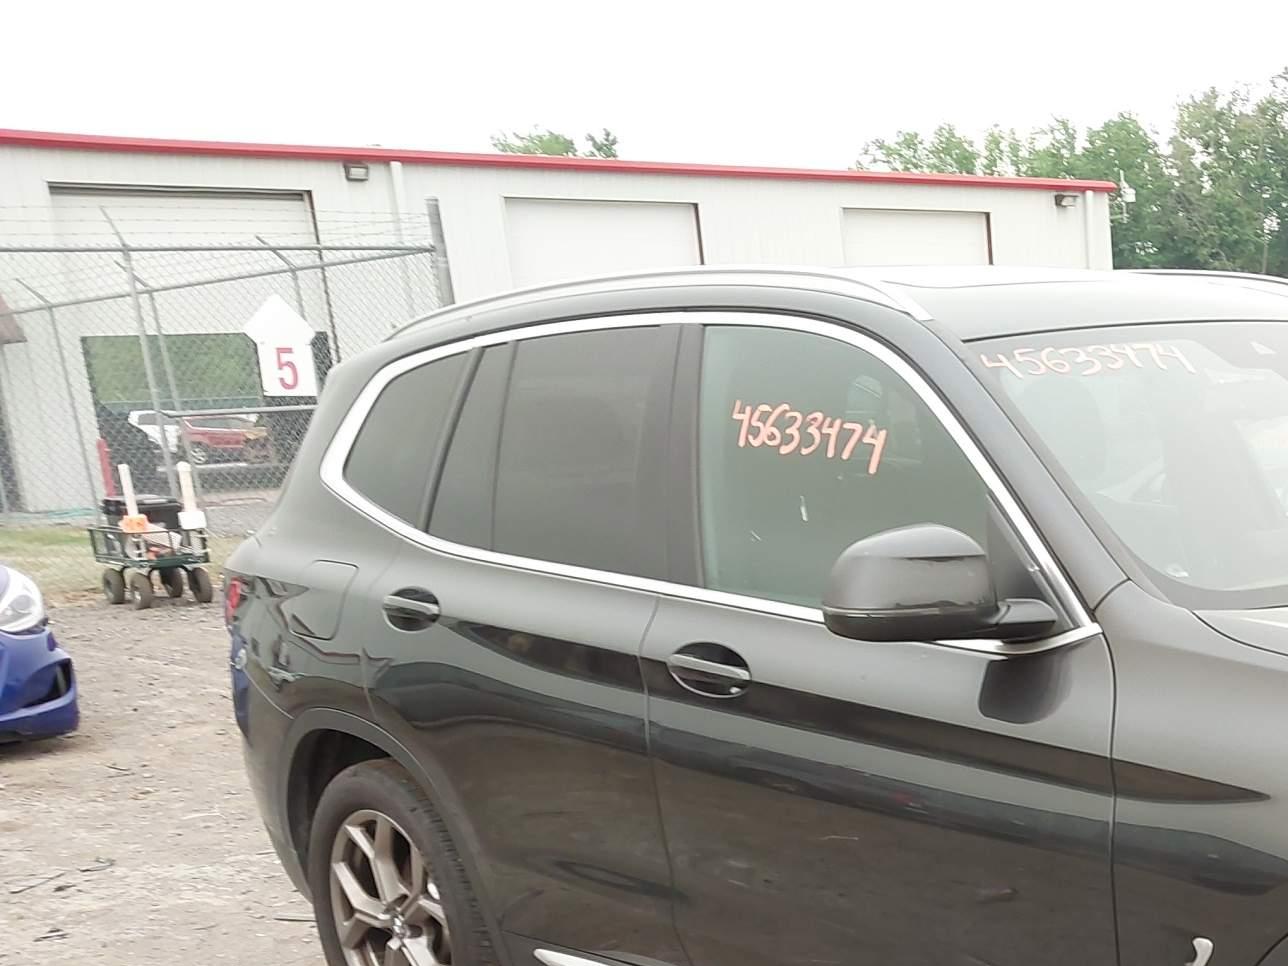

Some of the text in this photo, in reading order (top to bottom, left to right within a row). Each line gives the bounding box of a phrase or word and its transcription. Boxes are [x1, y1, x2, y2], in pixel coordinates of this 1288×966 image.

[275, 347, 299, 390] 5
[979, 342, 1197, 380] 45633474
[731, 399, 888, 475] 45633474
